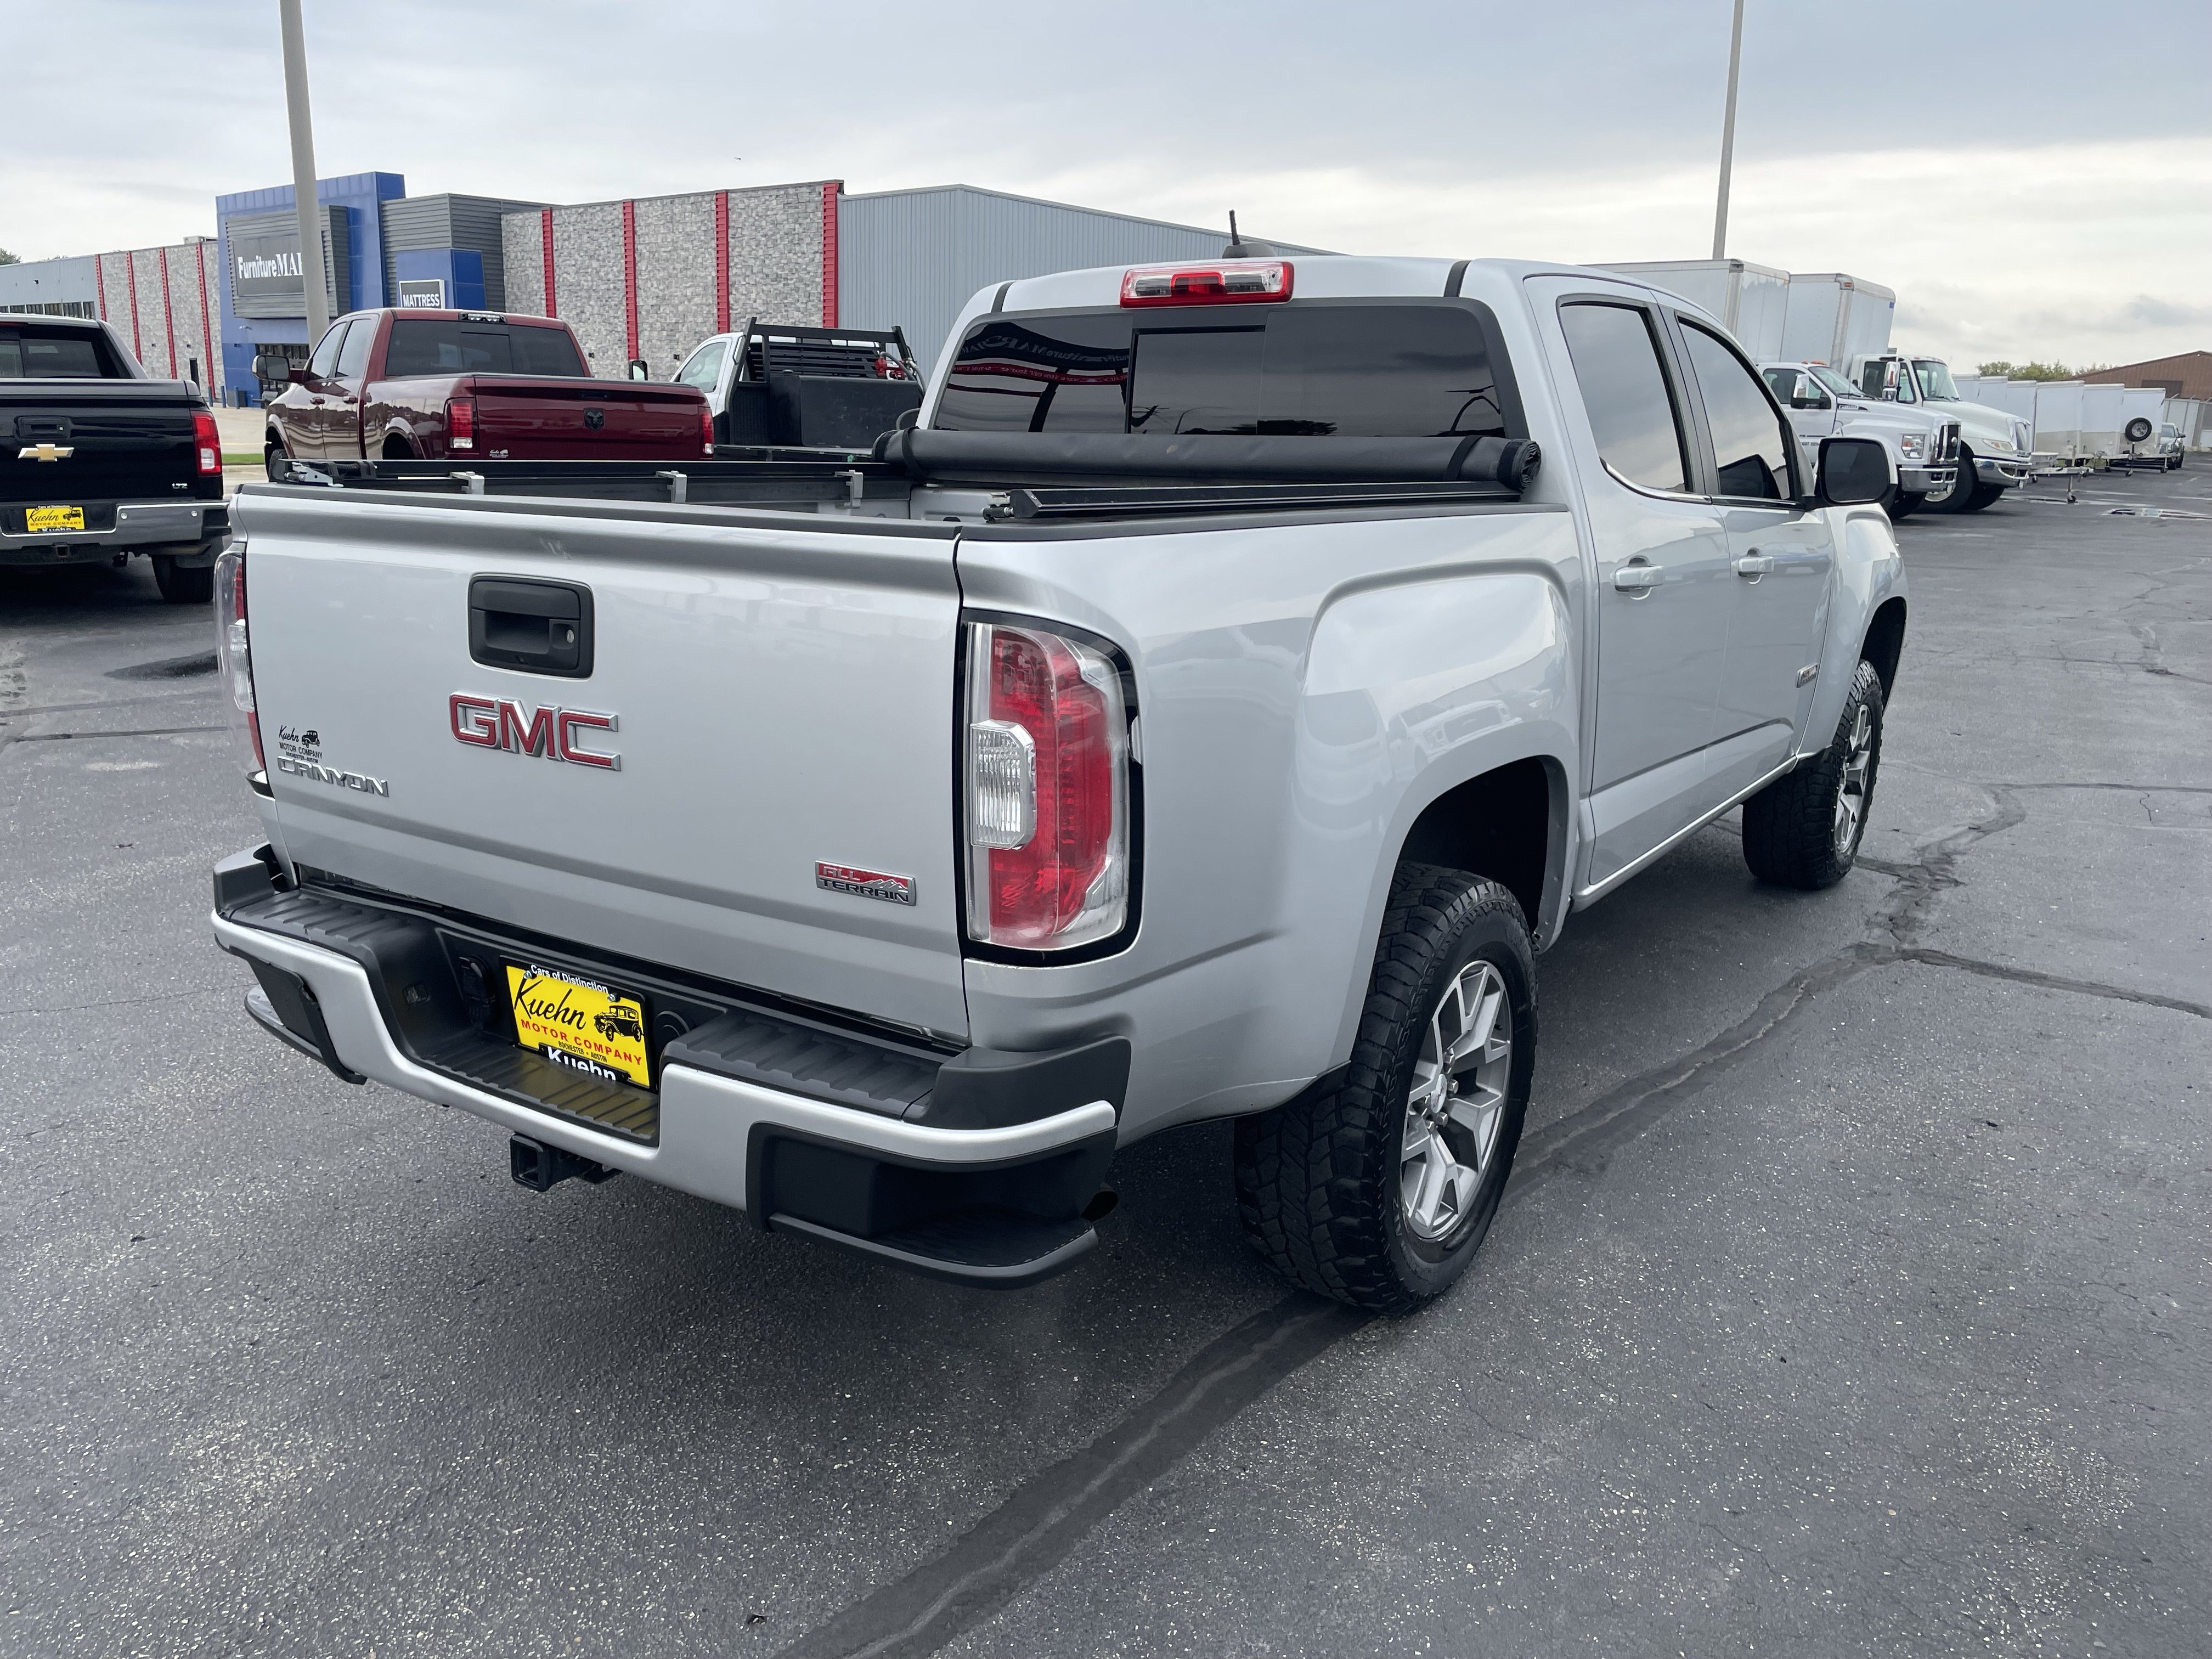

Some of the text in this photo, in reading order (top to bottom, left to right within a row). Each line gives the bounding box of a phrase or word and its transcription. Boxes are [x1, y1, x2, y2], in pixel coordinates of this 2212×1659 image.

[403, 294, 439, 307] MATTRESS
[28, 510, 59, 523] Kuehn
[279, 725, 300, 742] Kuehn
[449, 691, 621, 771] GMC
[279, 742, 323, 759] MOTOR COMPANY
[277, 756, 389, 798] CANYON
[823, 866, 861, 881] ALL
[819, 878, 909, 904] TERRAIN
[531, 964, 608, 994] Cars of Distinction
[514, 974, 586, 1030] Kuehn
[521, 1019, 642, 1066] MOTOR COMPANY
[558, 1041, 607, 1063] ROCHESTER AUSTIN
